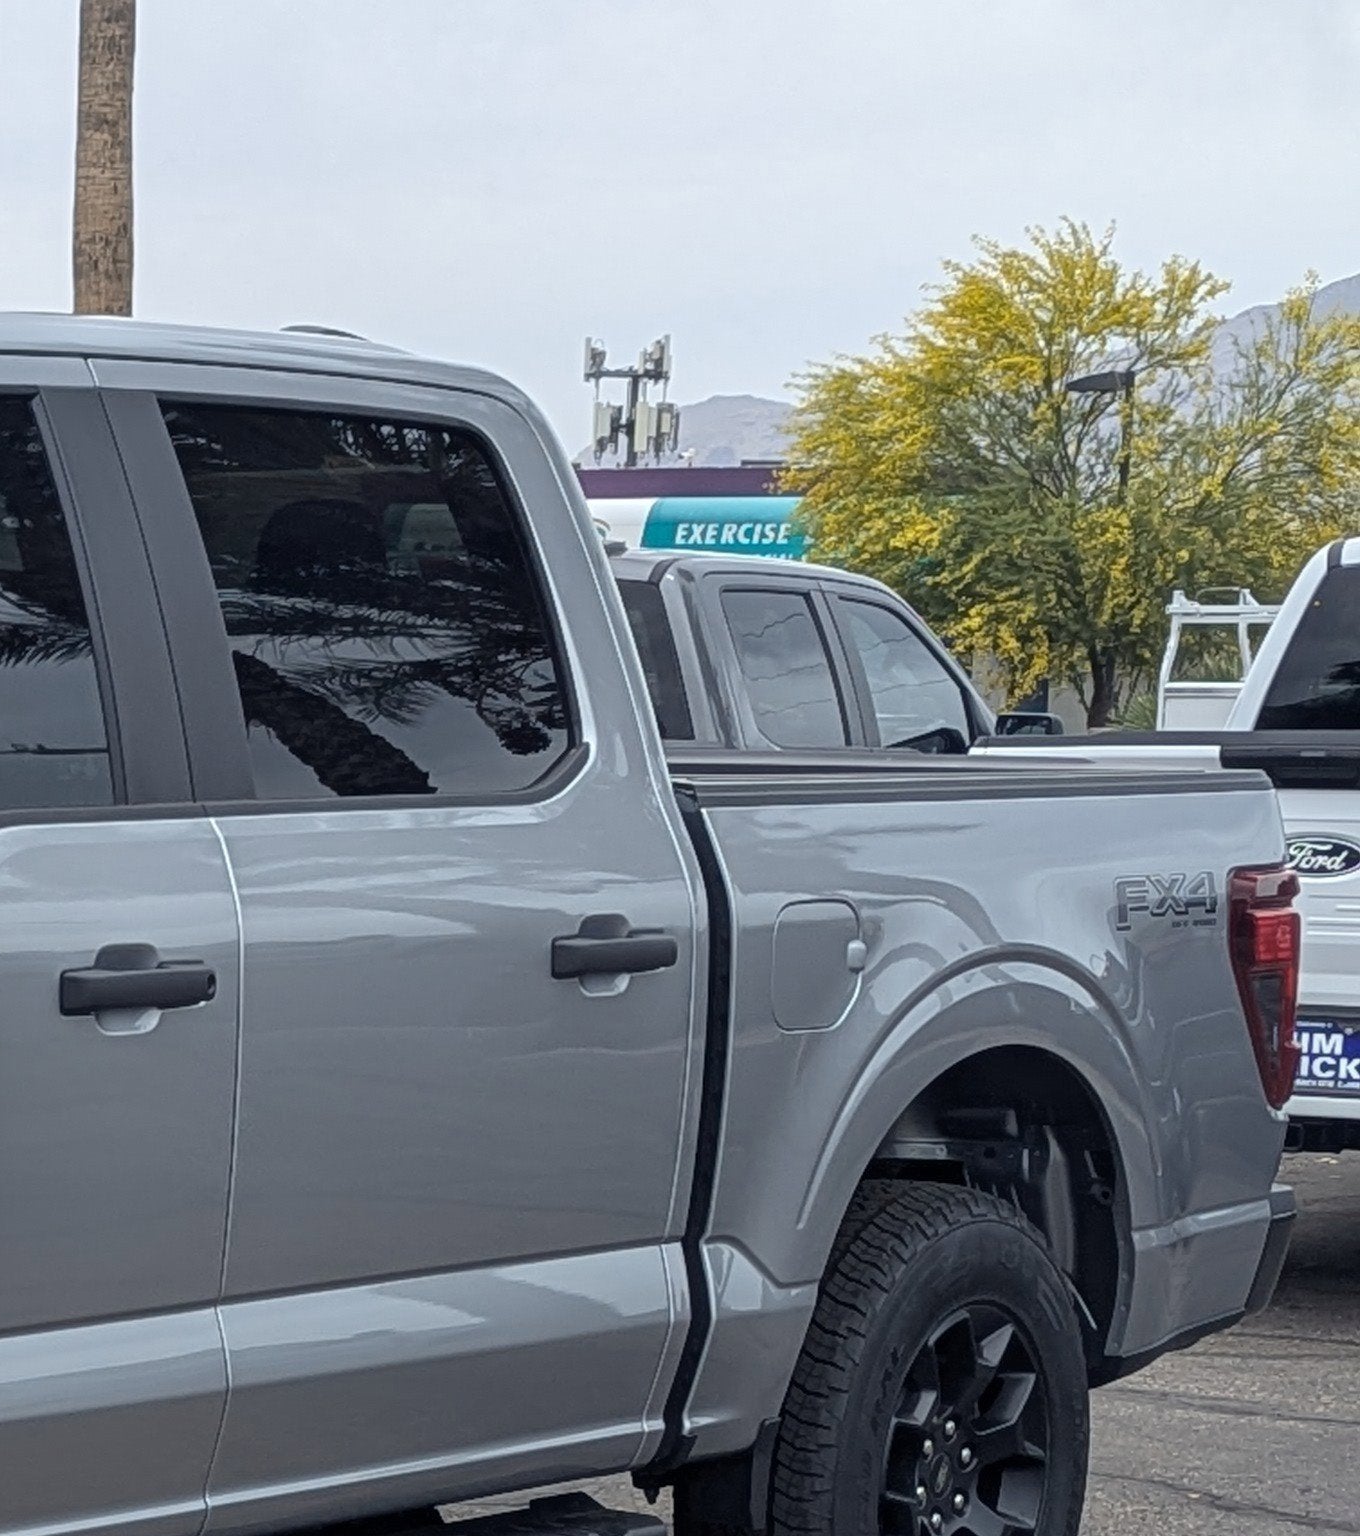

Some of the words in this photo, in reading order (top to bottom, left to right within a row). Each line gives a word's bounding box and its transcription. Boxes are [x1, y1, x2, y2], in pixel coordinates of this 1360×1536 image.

[675, 523, 792, 545] EXERCISE
[1284, 843, 1349, 870] Ford
[1114, 871, 1218, 931] FX4
